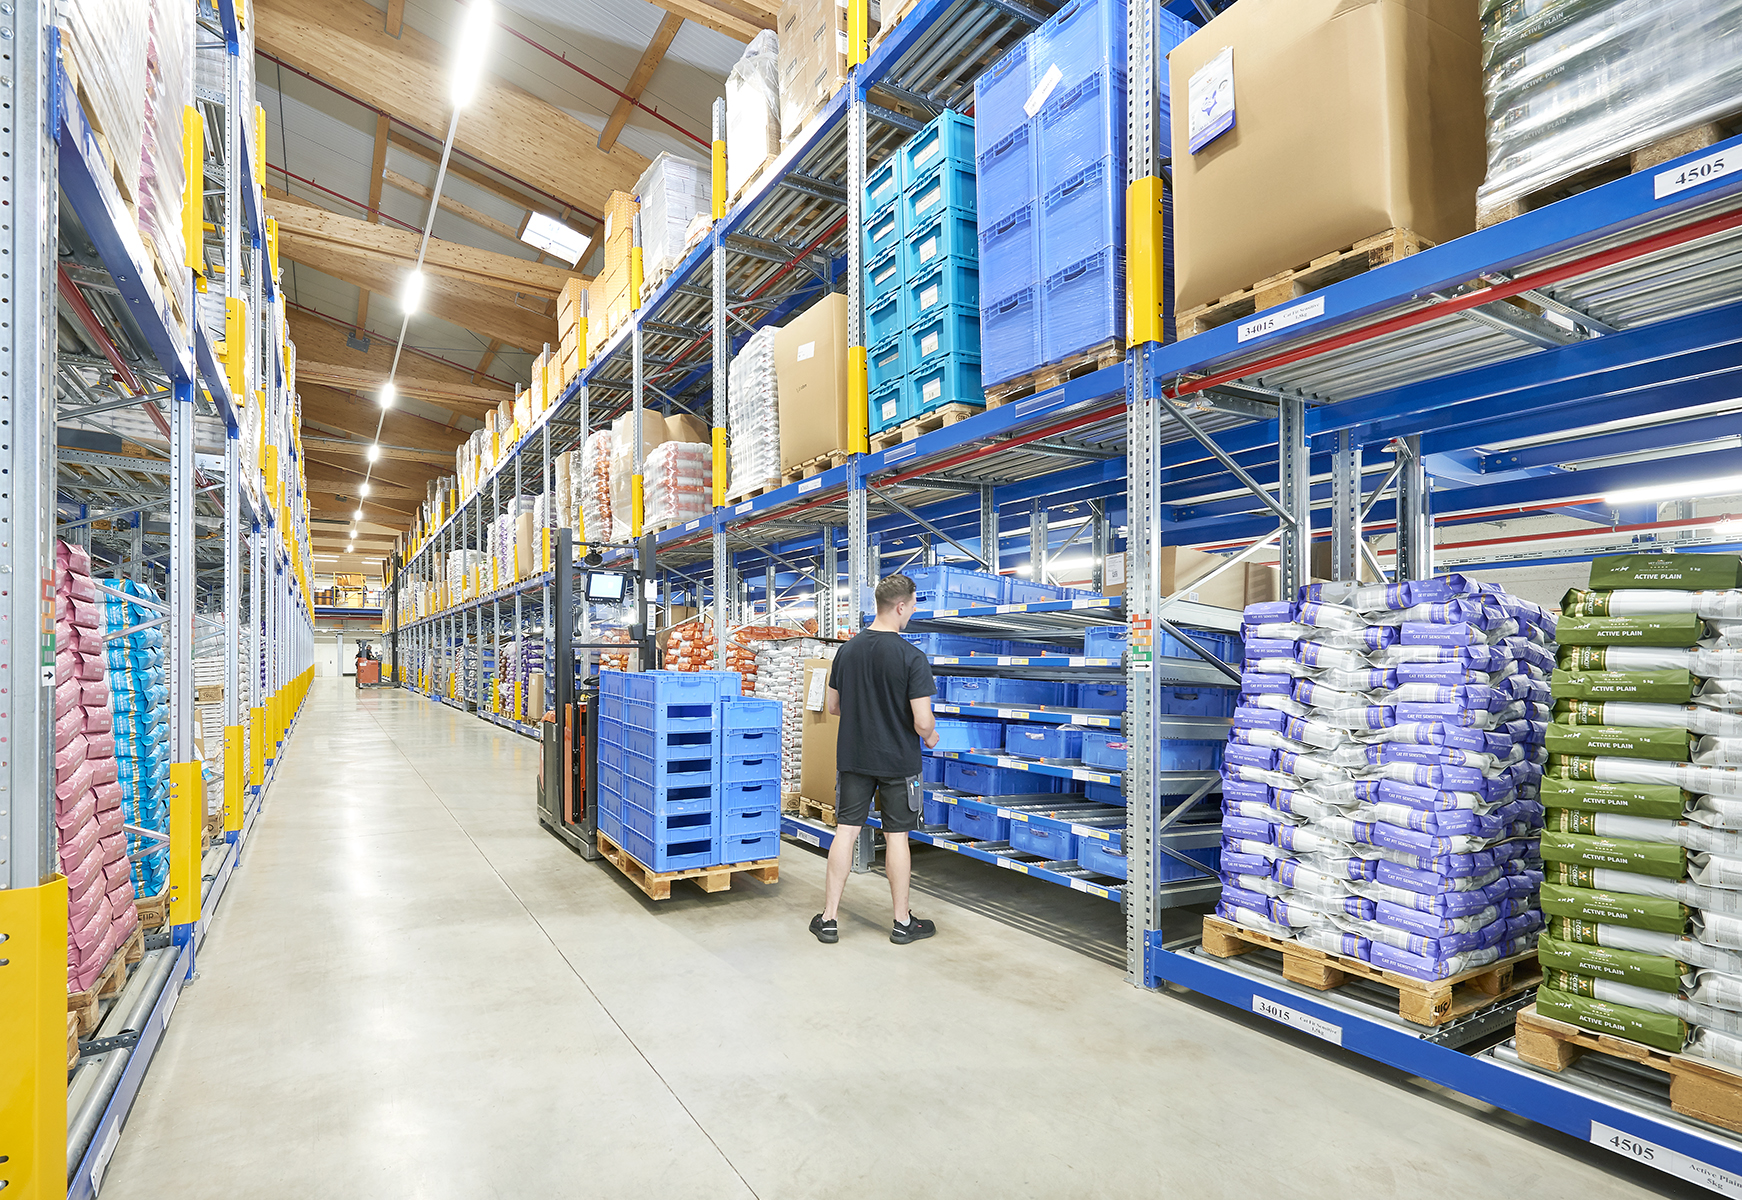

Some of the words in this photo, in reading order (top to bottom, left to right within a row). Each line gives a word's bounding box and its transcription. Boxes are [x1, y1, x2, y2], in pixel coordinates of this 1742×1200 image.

[1520, 26, 1542, 39] ACTIVE
[1544, 12, 1564, 26] PLAIN
[1675, 158, 1725, 184] 4505
[1245, 319, 1274, 336] 34015
[1398, 840, 1416, 849] SENSITIVE
[1403, 878, 1423, 887] SENSITIVE
[1403, 919, 1424, 930] SENSITIVE
[1397, 962, 1418, 973] SENSITIVE
[1579, 962, 1602, 971] ACTIVE
[1604, 967, 1624, 976] PLAIN
[1260, 1002, 1290, 1020] 34015
[1579, 1015, 1602, 1026] ACTIVE
[1604, 1021, 1625, 1031] PLAIN
[1610, 1136, 1654, 1160] 4505
[1689, 1164, 1717, 1178] Active
[1719, 1175, 1742, 1188] Plain
[1707, 1178, 1724, 1190] 5kg
